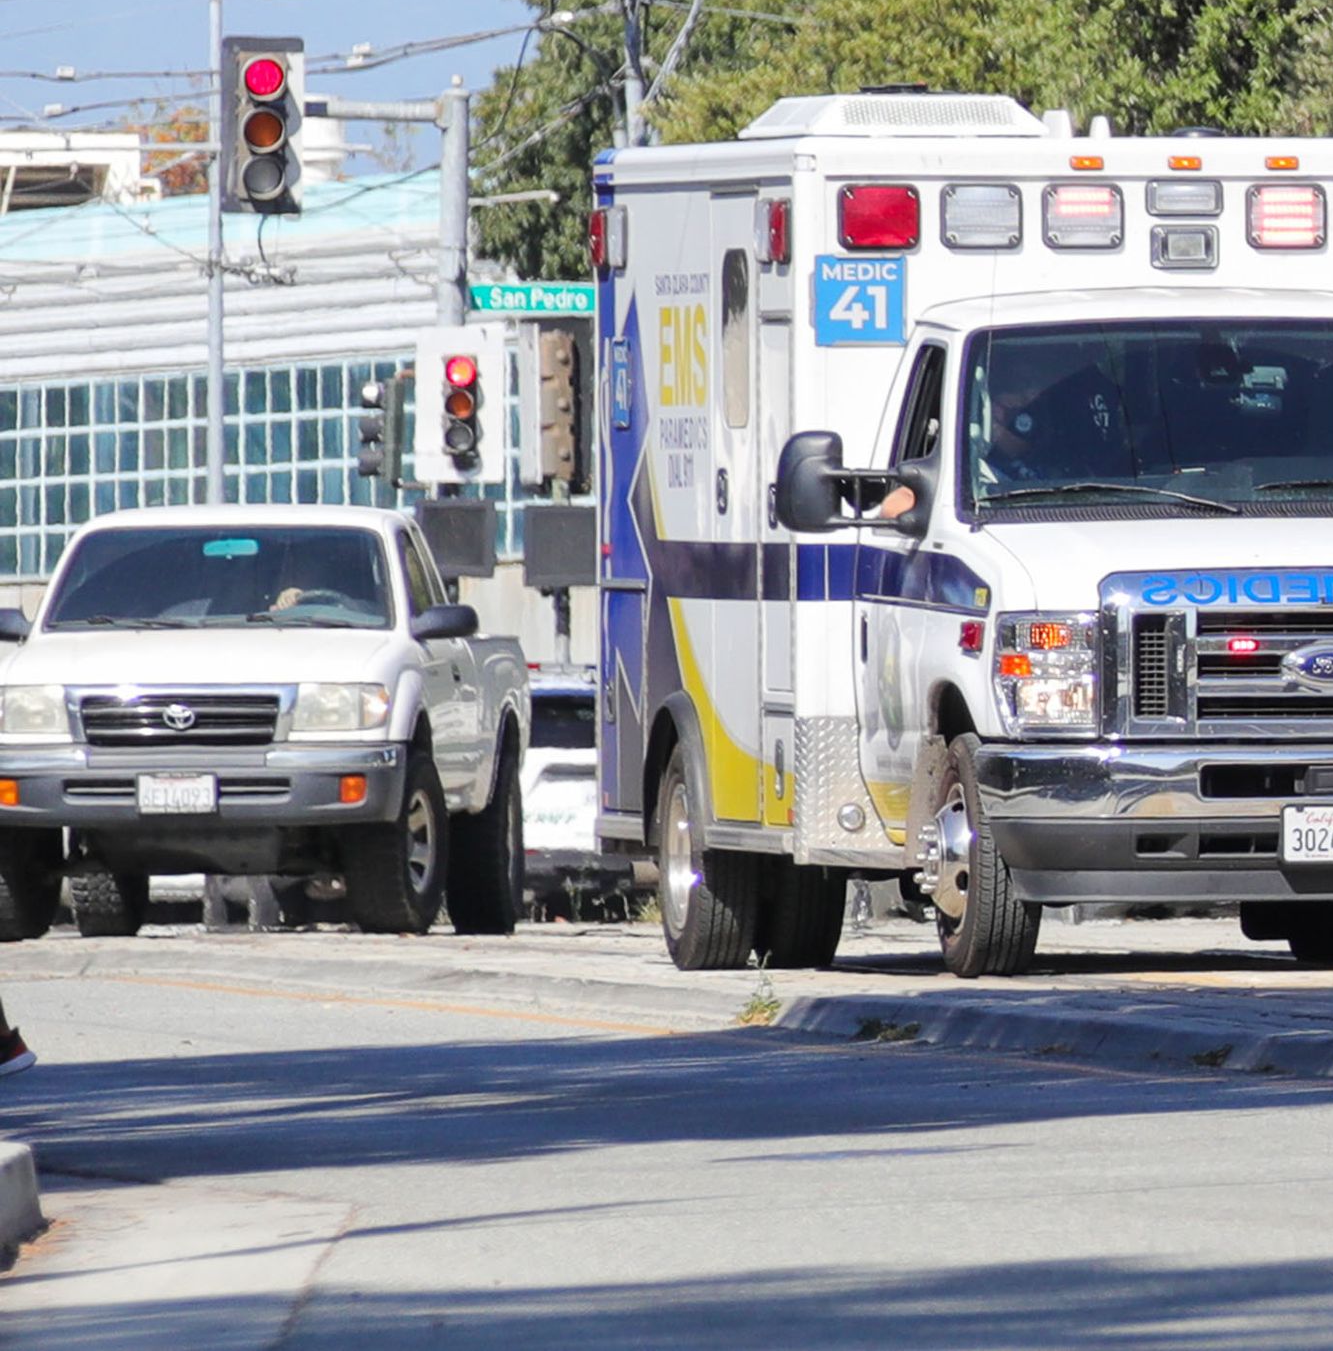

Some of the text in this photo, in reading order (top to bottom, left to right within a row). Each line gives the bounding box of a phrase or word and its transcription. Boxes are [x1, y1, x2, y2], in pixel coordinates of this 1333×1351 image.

[822, 263, 897, 281] MEDIC
[490, 287, 526, 309] San
[531, 286, 587, 309] Pedro
[829, 285, 888, 329] 41
[659, 303, 707, 407] EMS
